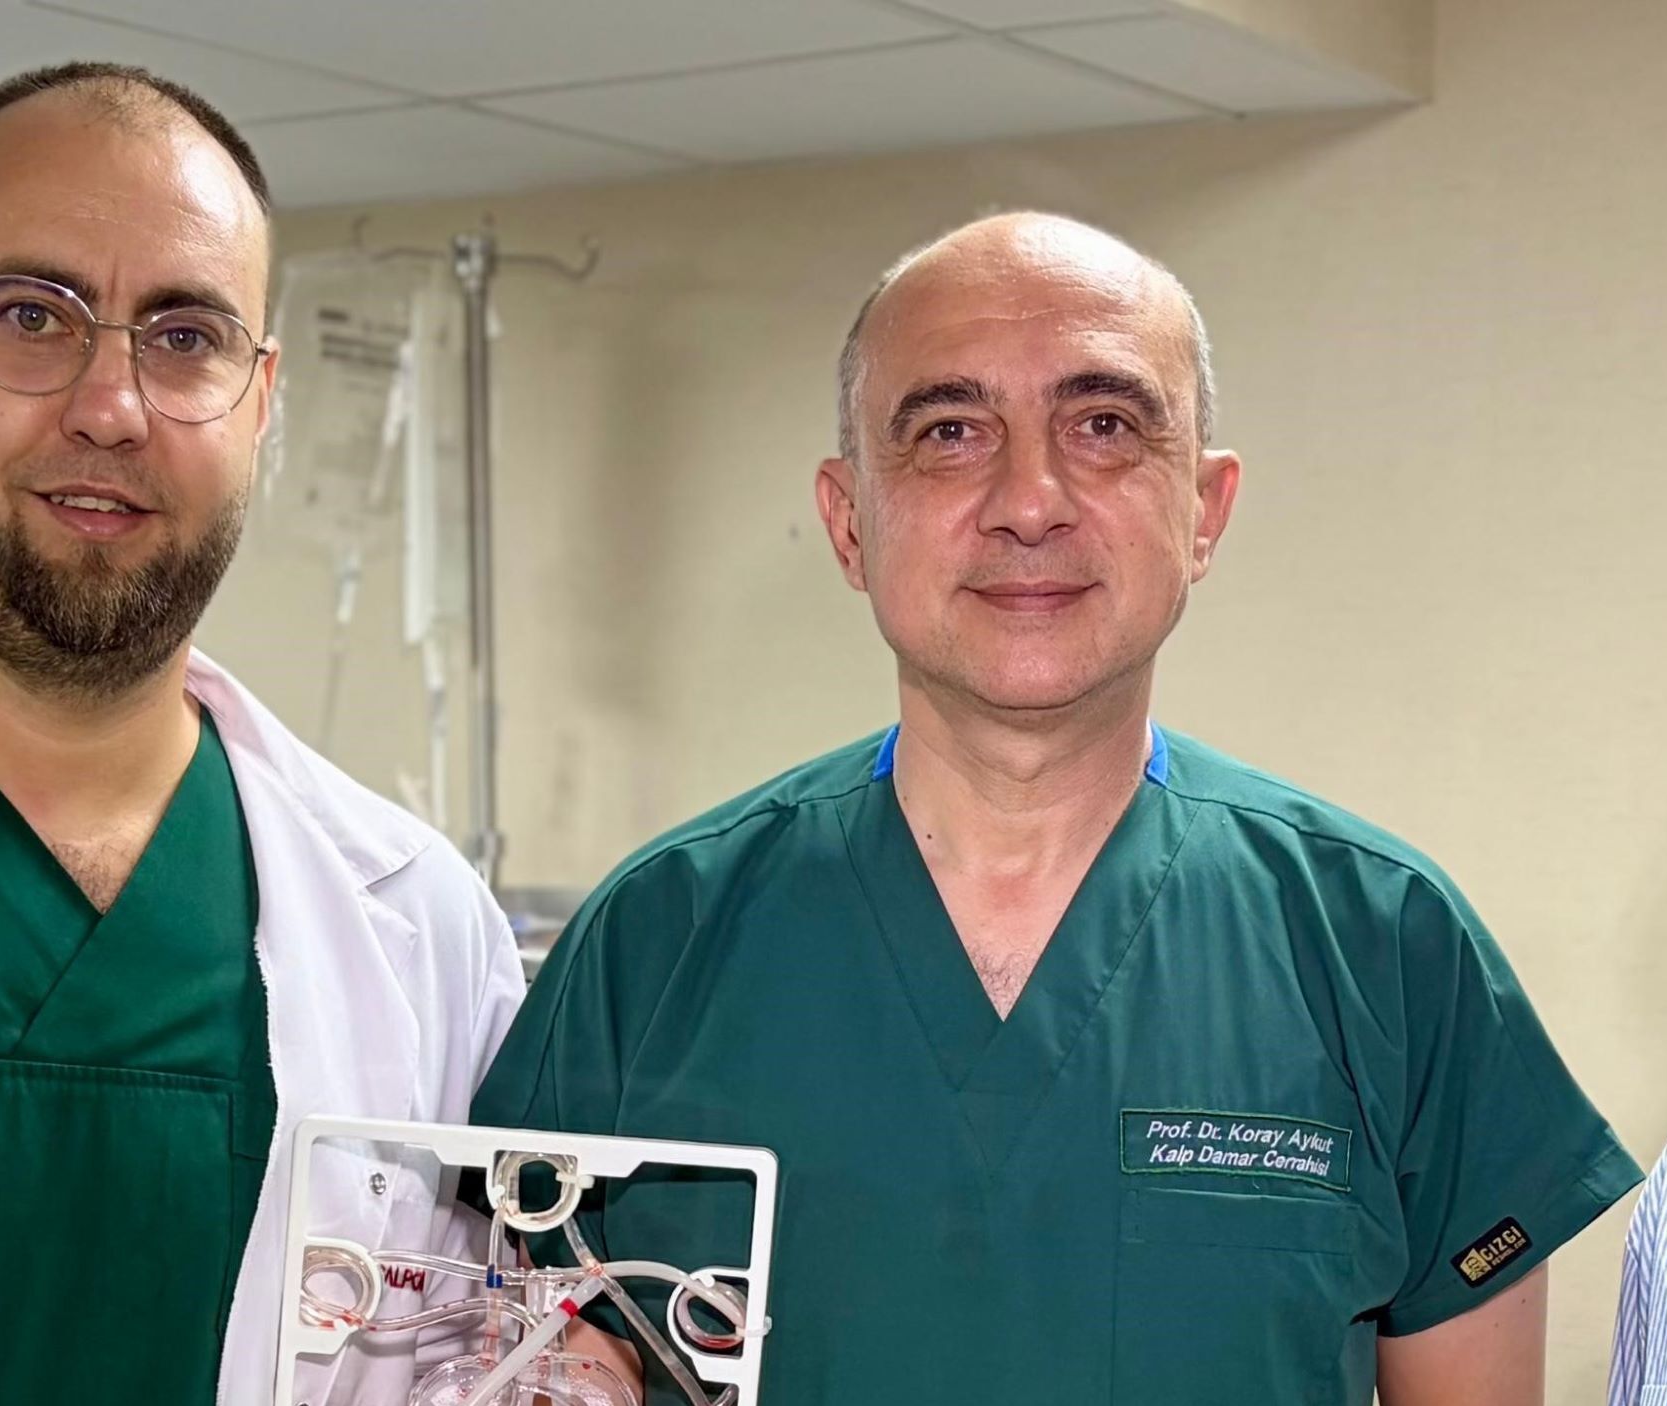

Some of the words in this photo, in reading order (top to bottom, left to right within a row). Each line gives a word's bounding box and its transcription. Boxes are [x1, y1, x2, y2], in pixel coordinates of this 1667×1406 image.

[1146, 1120, 1192, 1138] Prof.
[1197, 1121, 1222, 1140] Dr.
[1228, 1123, 1285, 1148] Koray
[1288, 1128, 1334, 1154] Aykut
[1149, 1144, 1194, 1166] Kalp
[1197, 1145, 1258, 1167] Damar
[1263, 1150, 1330, 1176] Cerrahisi
